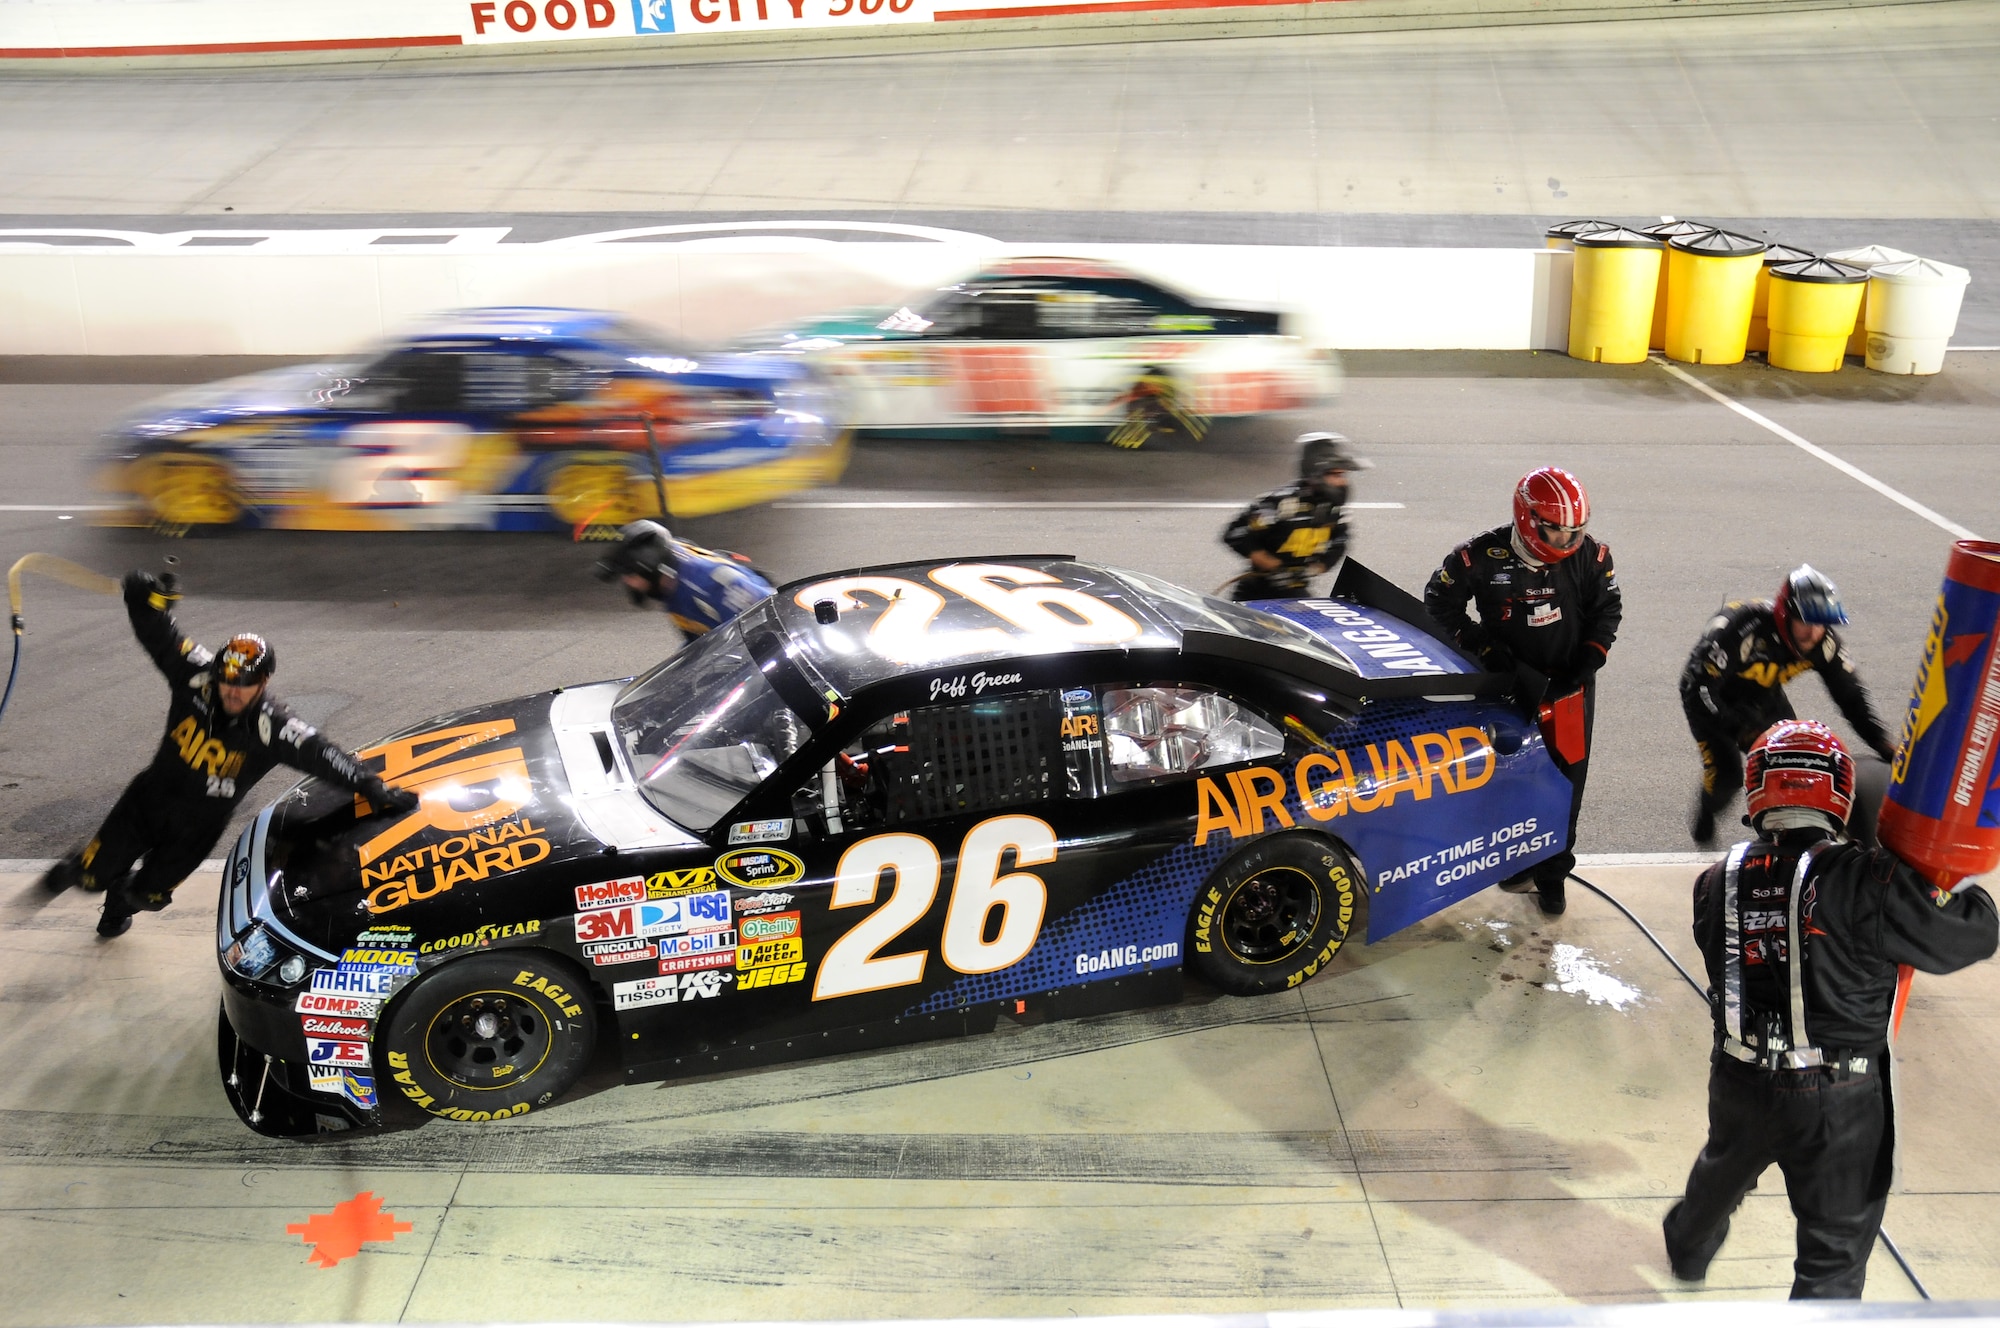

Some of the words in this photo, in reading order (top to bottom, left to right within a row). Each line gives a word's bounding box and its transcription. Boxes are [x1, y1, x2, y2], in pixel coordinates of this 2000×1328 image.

[471, 0, 616, 34] FOOD
[690, 0, 804, 23] CITY
[793, 563, 1143, 668] 26
[930, 678, 967, 701] Jeff
[971, 671, 1022, 695] Green
[1061, 715, 1093, 738] AIR
[1953, 748, 1983, 807] OFFICIAL
[1971, 712, 1993, 750] FUEL
[1194, 767, 1295, 847] AIR
[1295, 727, 1496, 822] GUARD
[361, 818, 546, 889] NATIONAL
[1379, 837, 1484, 888] PART-TIME
[1489, 817, 1537, 847] JOBS
[1436, 852, 1500, 887] GOING
[1506, 831, 1558, 862] FAST.
[366, 837, 551, 914] GUARD
[746, 864, 775, 877] Sprint
[577, 879, 643, 902] Holley
[597, 896, 634, 906] CARBS
[648, 888, 690, 900] MECHANIX
[690, 883, 718, 894] WEAR
[763, 893, 795, 907] LIGHT
[689, 893, 728, 921] USG
[743, 905, 786, 916] POLE
[811, 814, 1058, 1002] 26
[577, 908, 634, 941] 3M
[643, 923, 683, 936] DIRECTV
[744, 919, 795, 937] O'Reilly
[1196, 886, 1222, 953] EAGLE
[1287, 866, 1354, 988] GOODYEAR
[356, 931, 416, 943] Gatorback
[420, 919, 541, 954] GOODYEAR
[587, 940, 645, 955] LINCOLN
[661, 934, 713, 954] Mobil
[341, 949, 417, 967] MOOG
[601, 950, 651, 963] WELDERS
[752, 950, 798, 966] Meter
[756, 943, 790, 955] Auto
[1075, 941, 1179, 976] GoANG.com
[340, 963, 378, 972] CHASSIS
[662, 954, 734, 972] CRAFTSMAN
[312, 970, 391, 994] MAHLE
[736, 961, 808, 990] JEGS
[300, 994, 360, 1012] COMP
[512, 970, 583, 1018] EAGLE
[616, 986, 677, 1003] TISSOT
[303, 1018, 369, 1036] Edelbrock
[311, 1042, 364, 1062] JE
[328, 1060, 371, 1068] PISTONS
[388, 1051, 531, 1123] GOODYEAR
